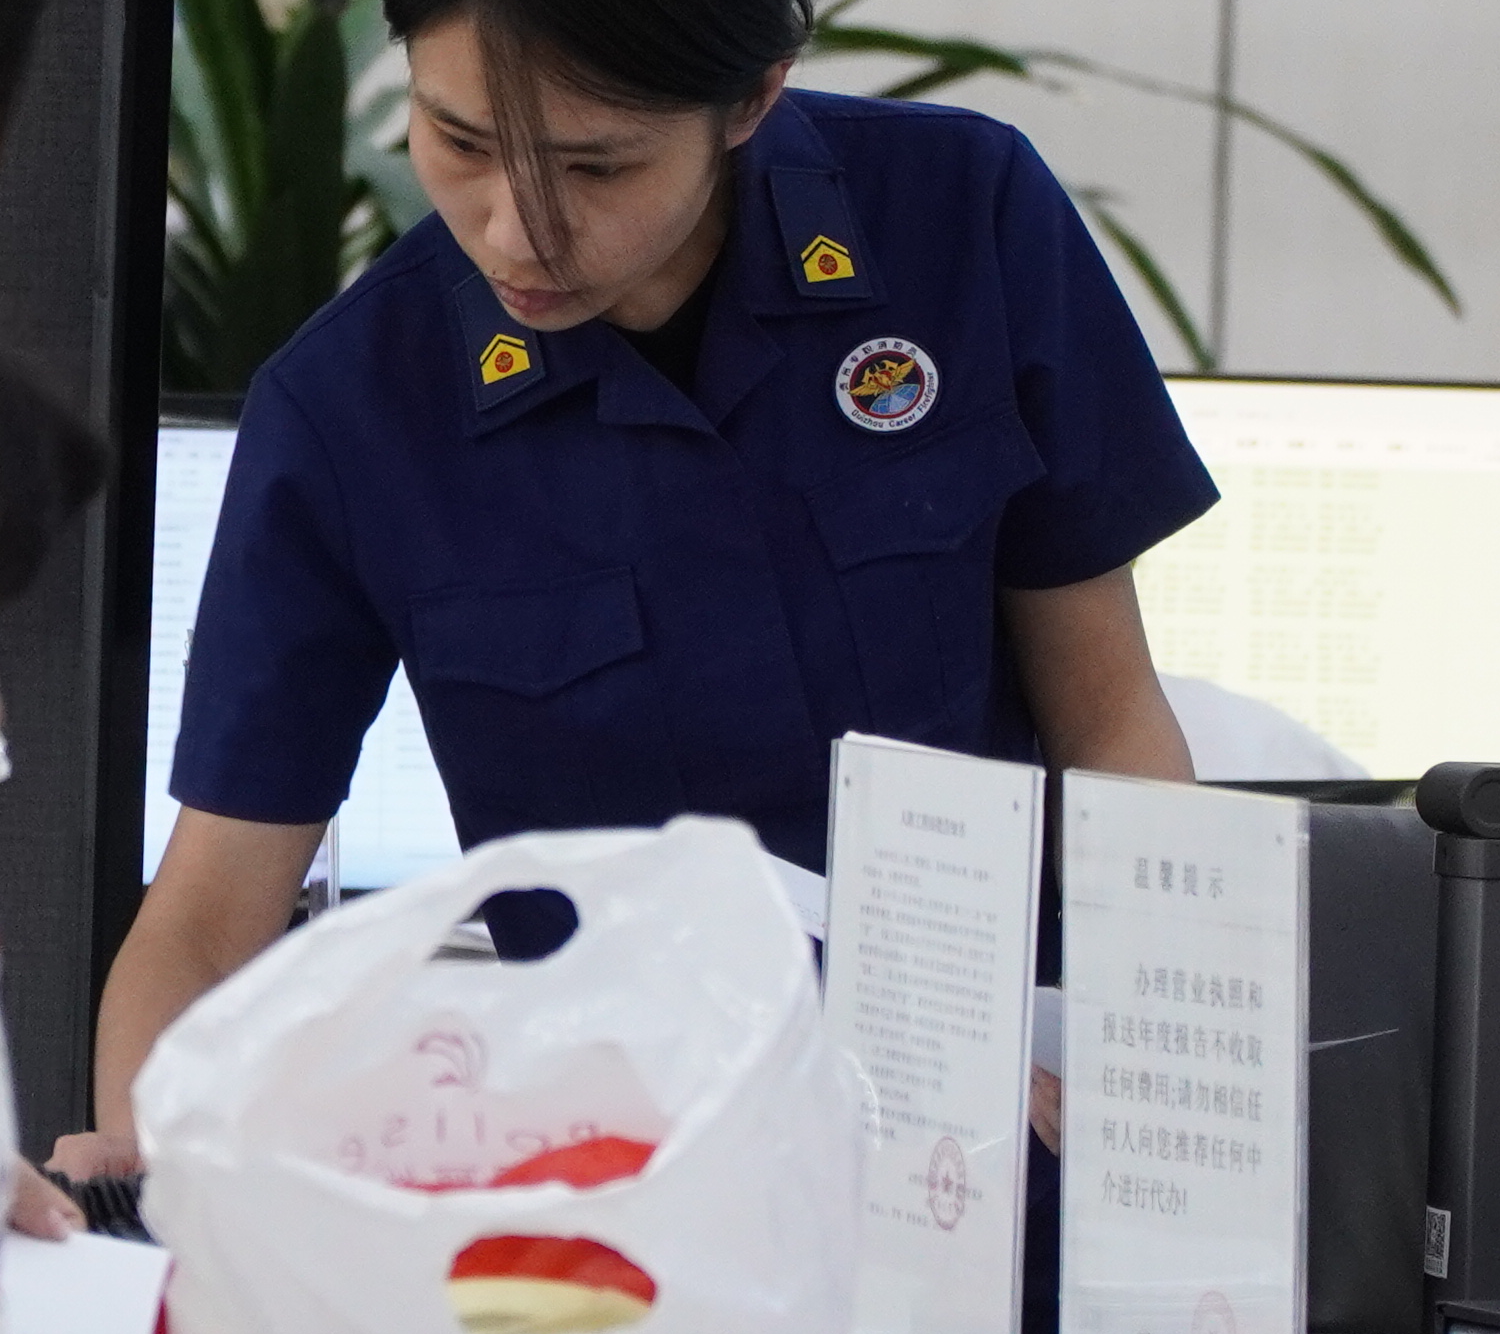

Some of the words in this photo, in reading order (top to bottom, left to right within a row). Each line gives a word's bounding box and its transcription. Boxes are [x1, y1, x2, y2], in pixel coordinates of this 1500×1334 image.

[889, 413, 917, 428] Career
[1134, 857, 1224, 899] 温馨提示
[1135, 963, 1262, 1009] 办理营业执照和
[1102, 1012, 1262, 1067] 报送年度报告不收取
[1102, 1119, 1261, 1173] 何人向您推荐任何中
